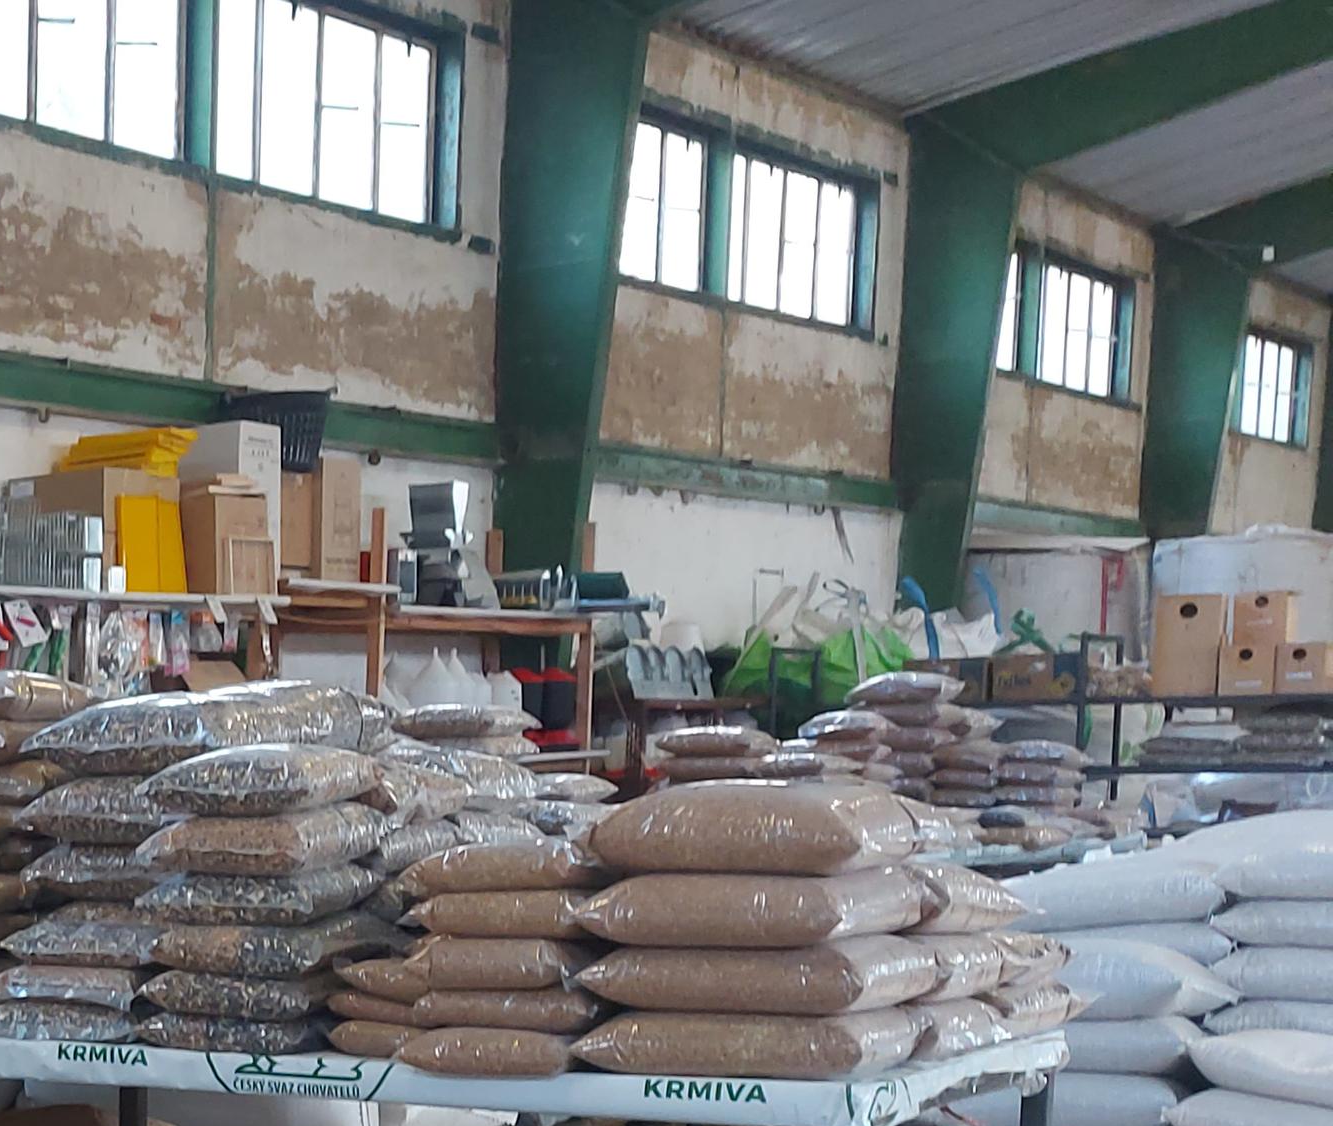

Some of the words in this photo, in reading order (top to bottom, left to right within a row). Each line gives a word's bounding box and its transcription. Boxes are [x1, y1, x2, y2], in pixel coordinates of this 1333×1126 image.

[57, 1043, 148, 1067] KRMIVA
[233, 1077, 266, 1092] ČESKÝ
[268, 1080, 295, 1094] SVAZ
[298, 1082, 361, 1097] CHOVATELŮ
[644, 1078, 767, 1104] KRMIVA
